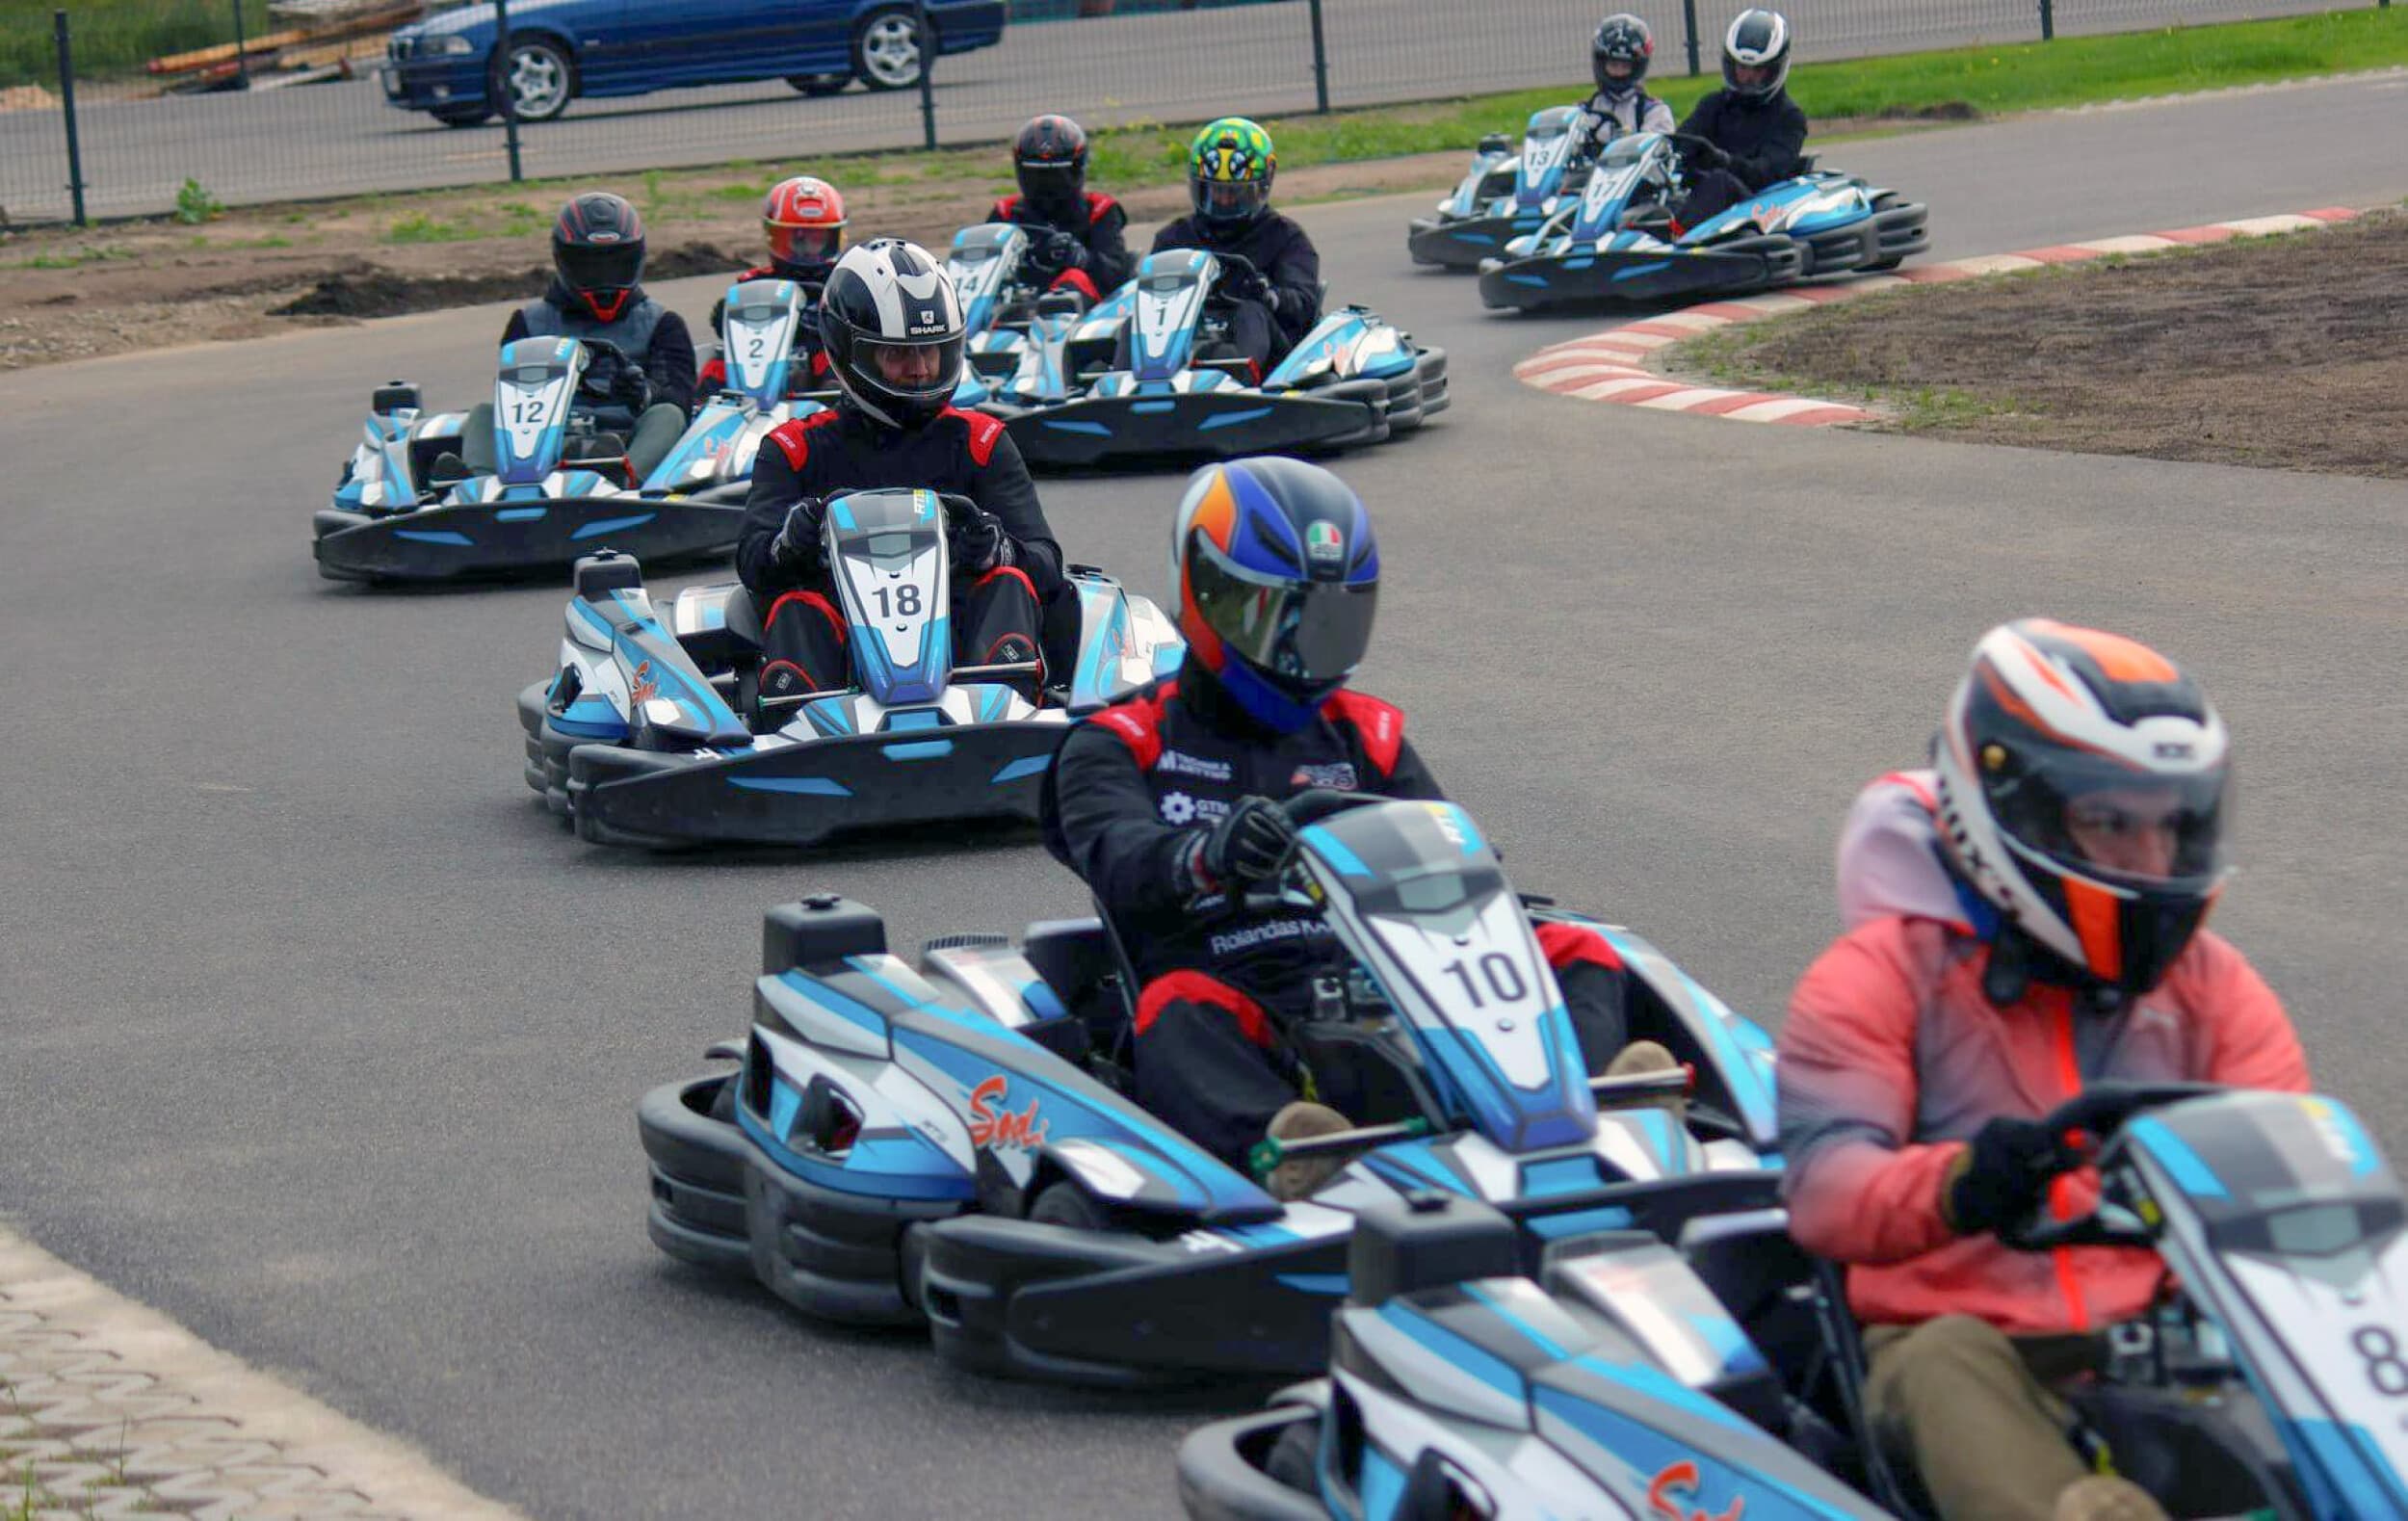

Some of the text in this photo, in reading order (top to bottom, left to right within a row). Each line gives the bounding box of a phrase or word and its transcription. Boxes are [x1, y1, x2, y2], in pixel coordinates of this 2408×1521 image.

[1529, 150, 1550, 167] 13
[1592, 181, 1617, 198] 17
[1155, 306, 1166, 326] 1
[909, 324, 946, 335] SHARK
[748, 338, 764, 358] 2
[510, 401, 544, 424] 12
[871, 584, 922, 618] 18
[1210, 918, 1298, 955] Rolandas
[1442, 951, 1528, 1009] 10
[2348, 1324, 2408, 1396] 8
